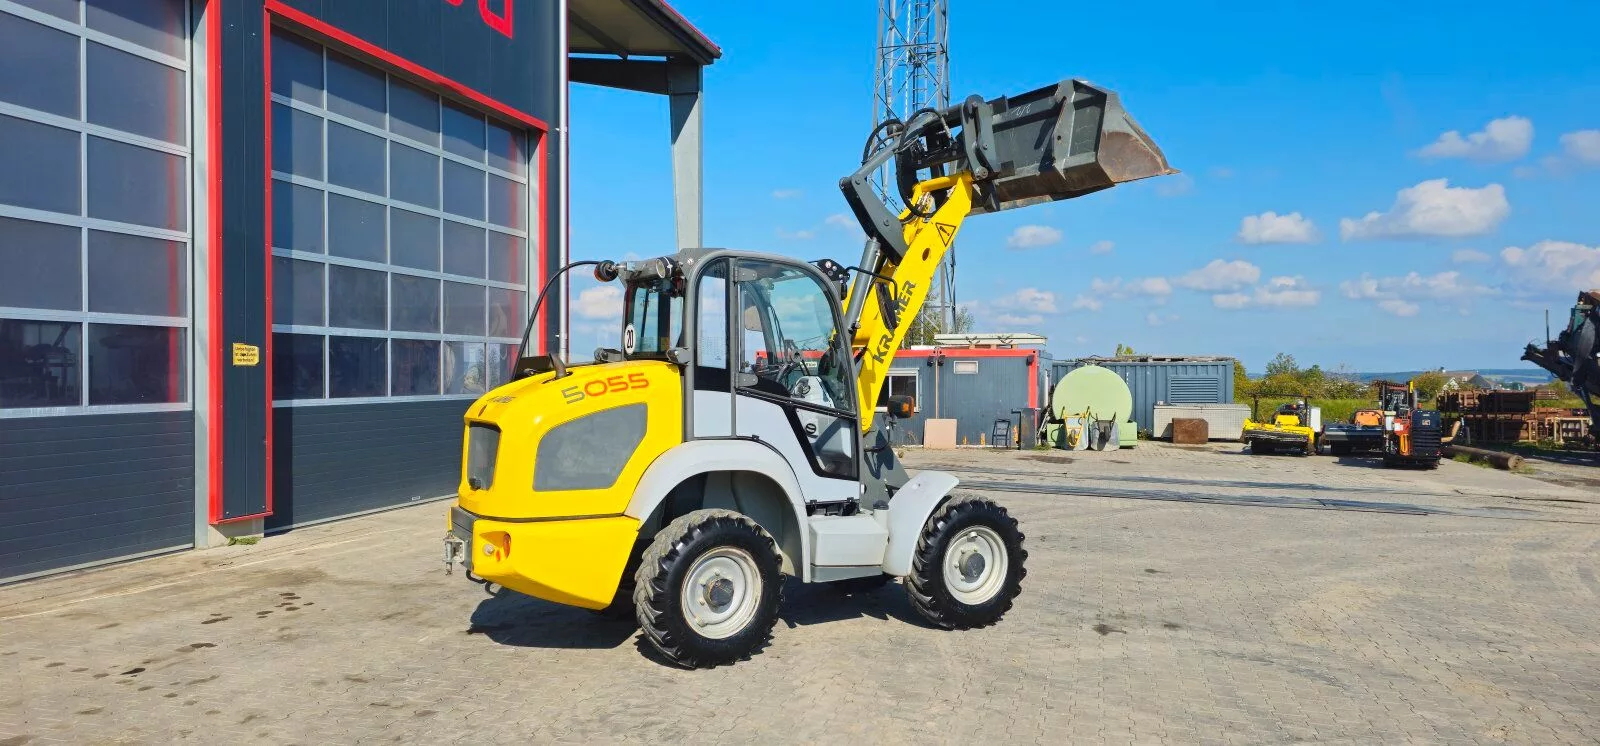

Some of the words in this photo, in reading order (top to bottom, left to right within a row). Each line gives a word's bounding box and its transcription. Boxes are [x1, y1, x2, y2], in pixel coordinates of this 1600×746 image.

[872, 280, 917, 364] KRMER
[626, 329, 634, 349] 20
[561, 372, 650, 405] 5055
